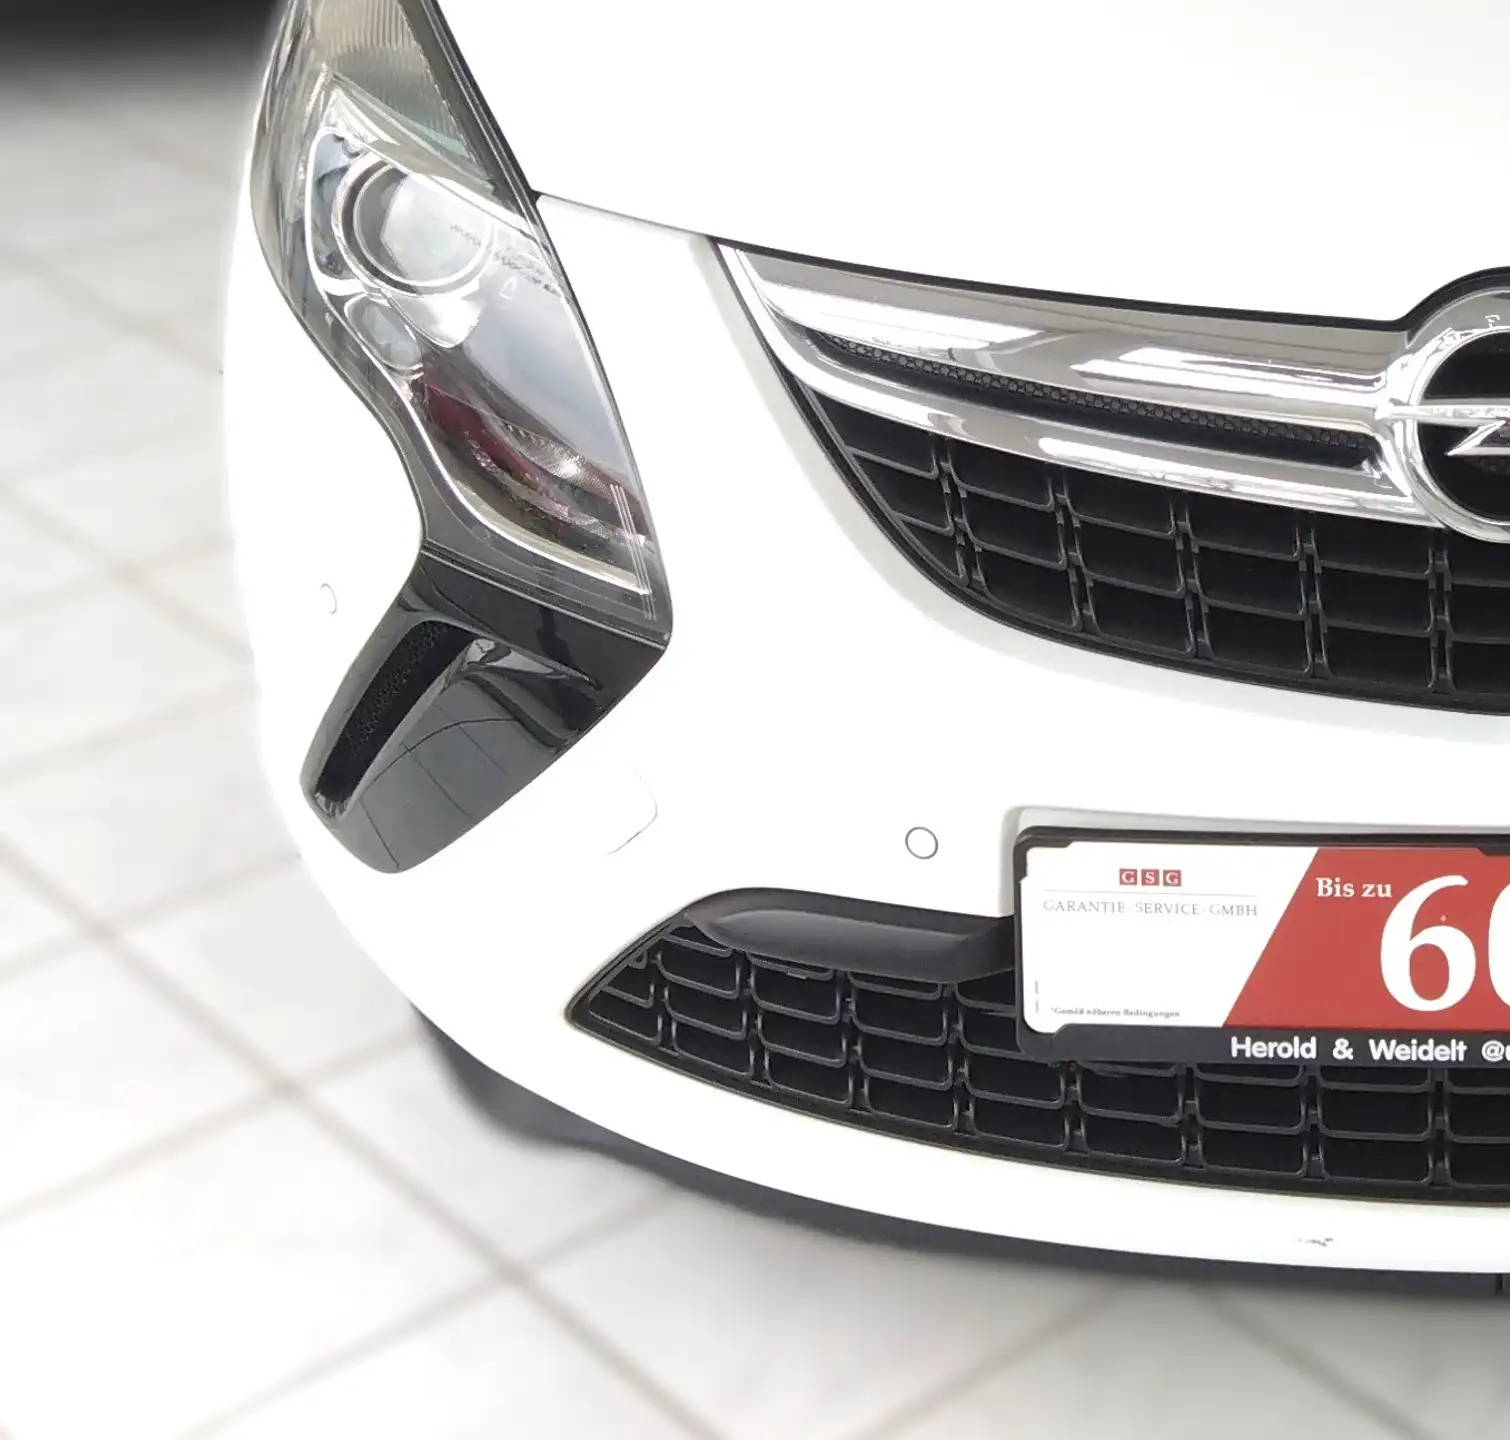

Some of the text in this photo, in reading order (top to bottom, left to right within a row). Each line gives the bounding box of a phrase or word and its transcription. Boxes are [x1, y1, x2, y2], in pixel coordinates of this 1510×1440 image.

[1119, 868, 1182, 887] GSG
[1315, 877, 1393, 898] Bis zu
[1209, 903, 1258, 917] GMBH
[1230, 1035, 1317, 1059] Herold
[1332, 1038, 1354, 1060] &
[1368, 1037, 1468, 1061] Weidelt
